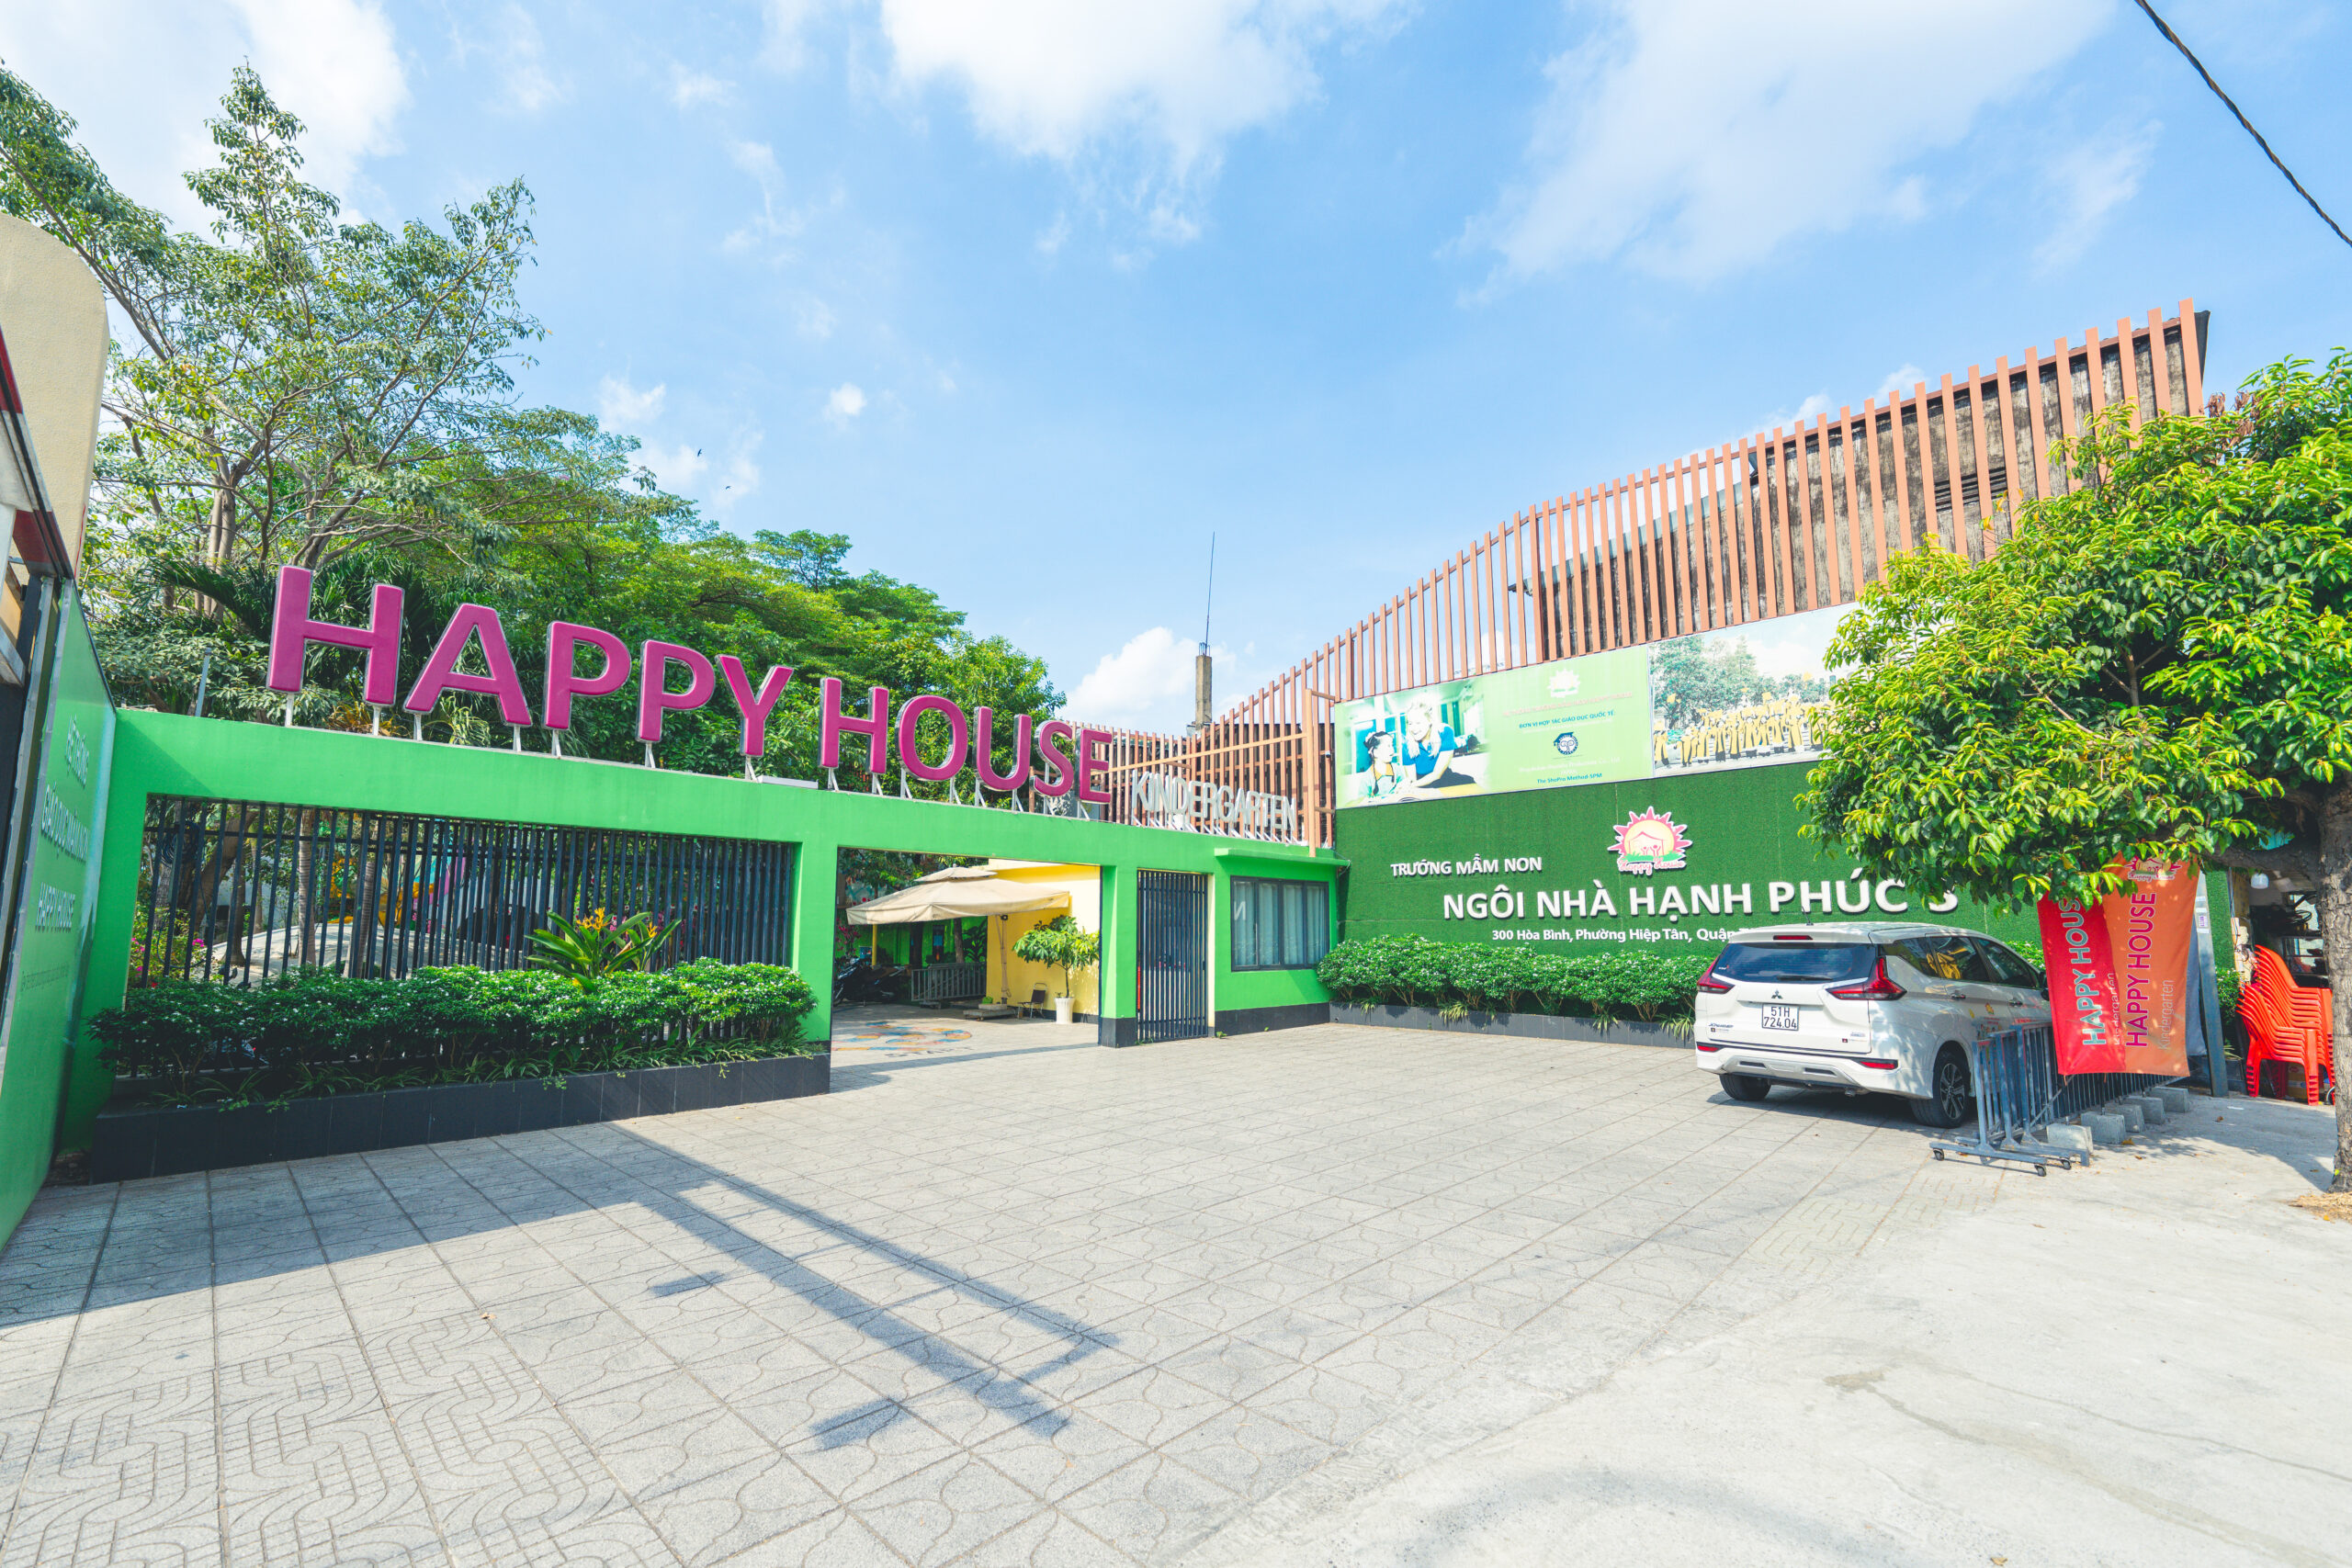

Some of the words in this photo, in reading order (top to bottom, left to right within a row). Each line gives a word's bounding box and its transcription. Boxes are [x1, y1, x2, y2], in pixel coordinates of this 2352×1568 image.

[267, 564, 793, 757] HAPPY
[818, 678, 1113, 804] HOUSE
[1132, 770, 1296, 830] KINDERGARTEN
[1390, 858, 1452, 876] TRƯỜNG
[1456, 853, 1498, 874] MẦM
[1504, 856, 1543, 873] NON
[1443, 884, 1525, 919] NGÔI
[1537, 879, 1618, 918] NHÀ
[1629, 882, 1753, 922] HẠNH
[1769, 867, 1908, 913] PHÚC
[1492, 930, 1514, 941] 300
[1516, 929, 1541, 941] Hòa
[1543, 929, 1574, 943] Bình,
[1576, 928, 1626, 942] Phường
[1629, 927, 1661, 942] Hiệp
[1665, 928, 1692, 943] Tân,
[2059, 895, 2092, 964] HOUS
[2127, 892, 2156, 969] HOUSE
[1763, 1016, 1797, 1029] 724.04
[1770, 1006, 1791, 1017] 51H
[2072, 968, 2107, 1045] HAPPY
[2125, 974, 2150, 1047] HAPPY
[2159, 979, 2175, 1050] Kindergarten
